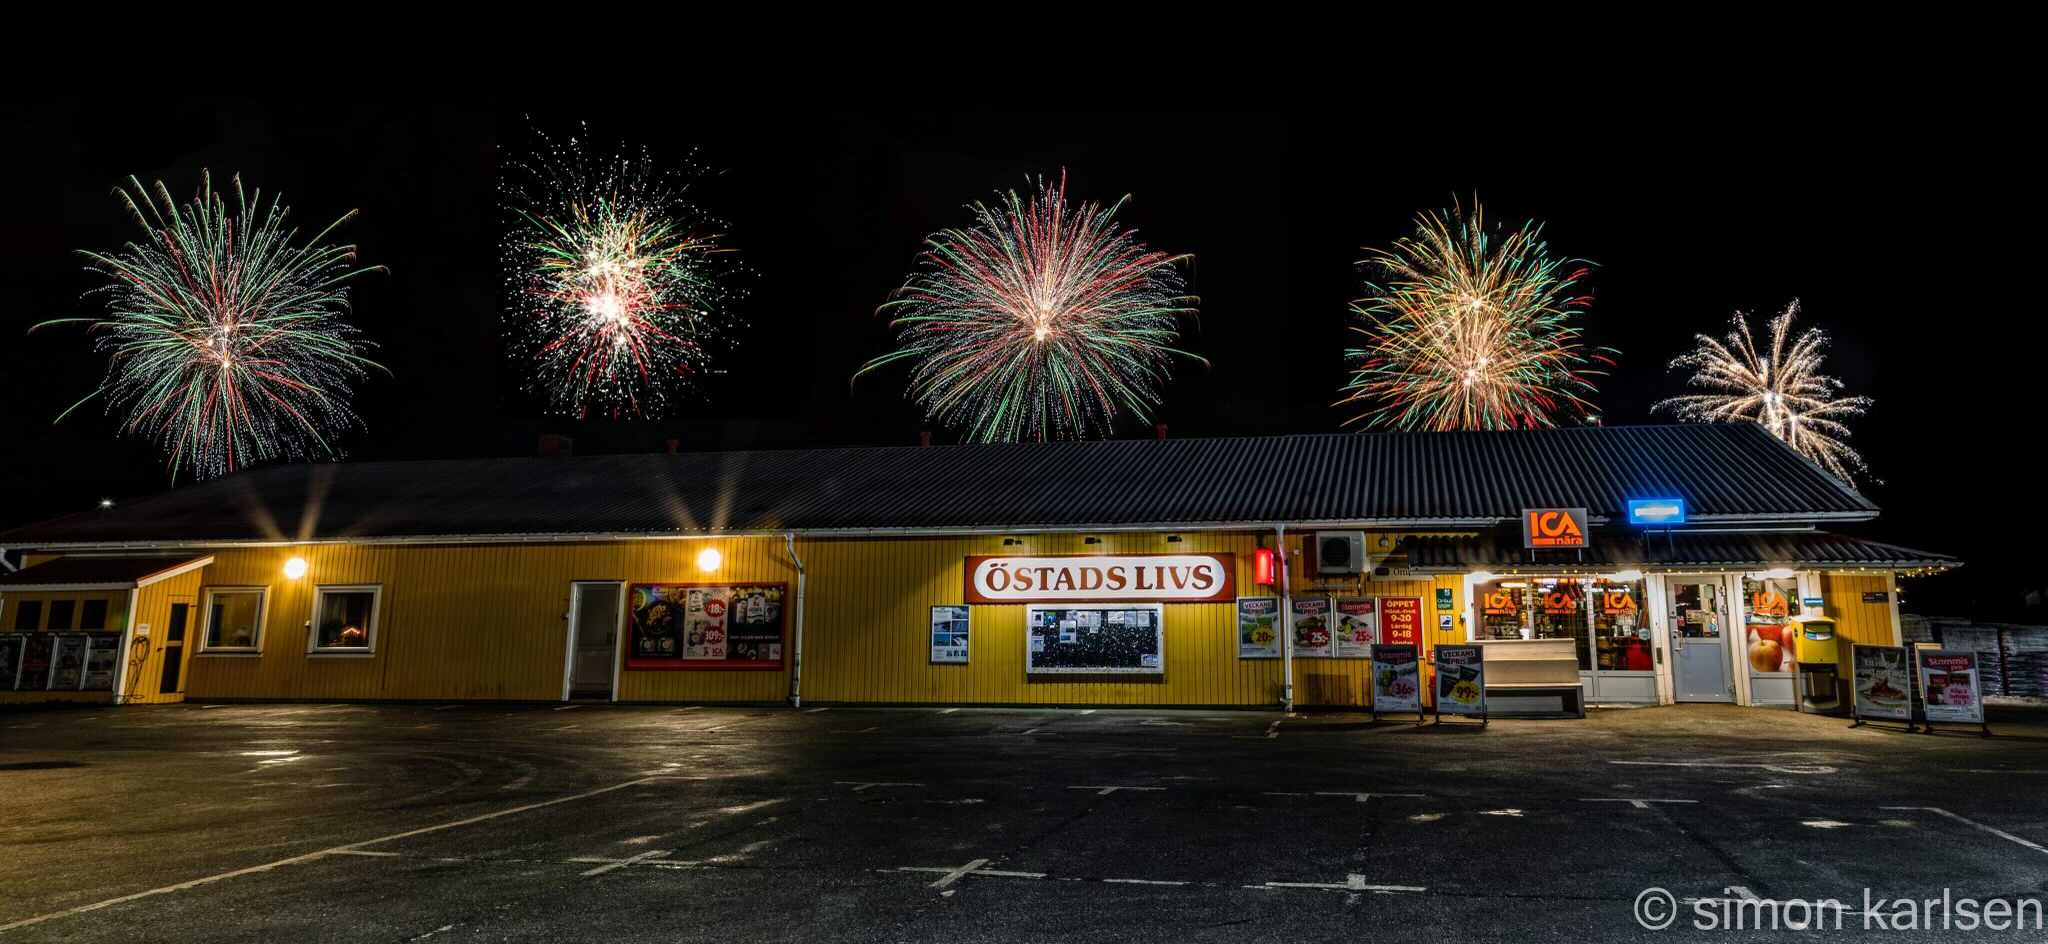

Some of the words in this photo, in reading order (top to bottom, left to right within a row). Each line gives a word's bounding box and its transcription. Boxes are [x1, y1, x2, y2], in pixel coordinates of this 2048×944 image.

[1530, 511, 1582, 537] ICA
[1558, 537, 1583, 545] nära
[985, 563, 1127, 592] ÖSTADS
[1134, 565, 1214, 590] LIVS
[1483, 592, 1515, 609] ICA
[1544, 592, 1575, 609] ICA
[1604, 592, 1636, 609] ICA
[1753, 591, 1788, 610] ICA
[1391, 614, 1412, 622] 9-20
[1392, 630, 1412, 638] 9-18
